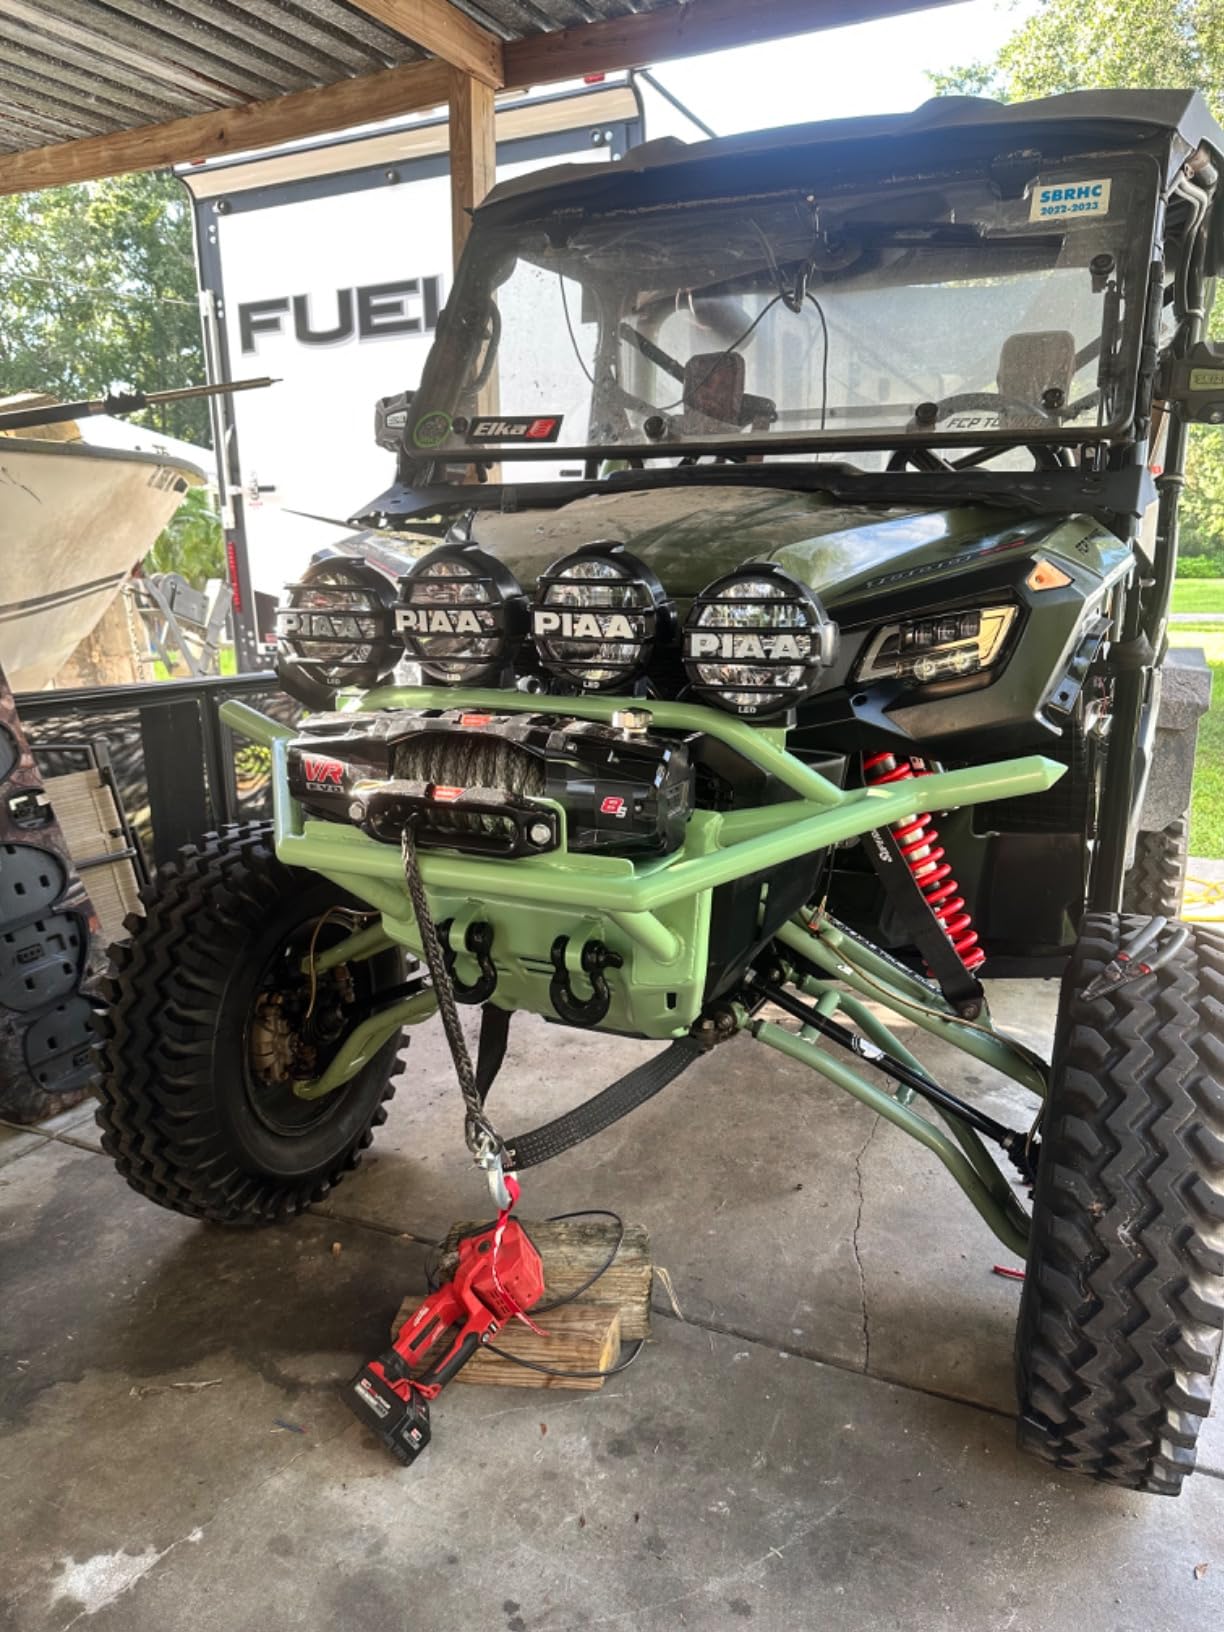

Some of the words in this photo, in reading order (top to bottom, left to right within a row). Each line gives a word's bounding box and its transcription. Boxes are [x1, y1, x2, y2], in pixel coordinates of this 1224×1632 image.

[1040, 184, 1102, 202] SBRHC
[1040, 202, 1099, 215] 2022-2023
[473, 422, 527, 437] Elka
[277, 613, 361, 638] PIAA
[395, 609, 483, 634] PIAA
[535, 611, 634, 639] PIAA
[691, 632, 803, 660] PIAA
[737, 705, 757, 714] LED
[305, 758, 344, 785] VR
